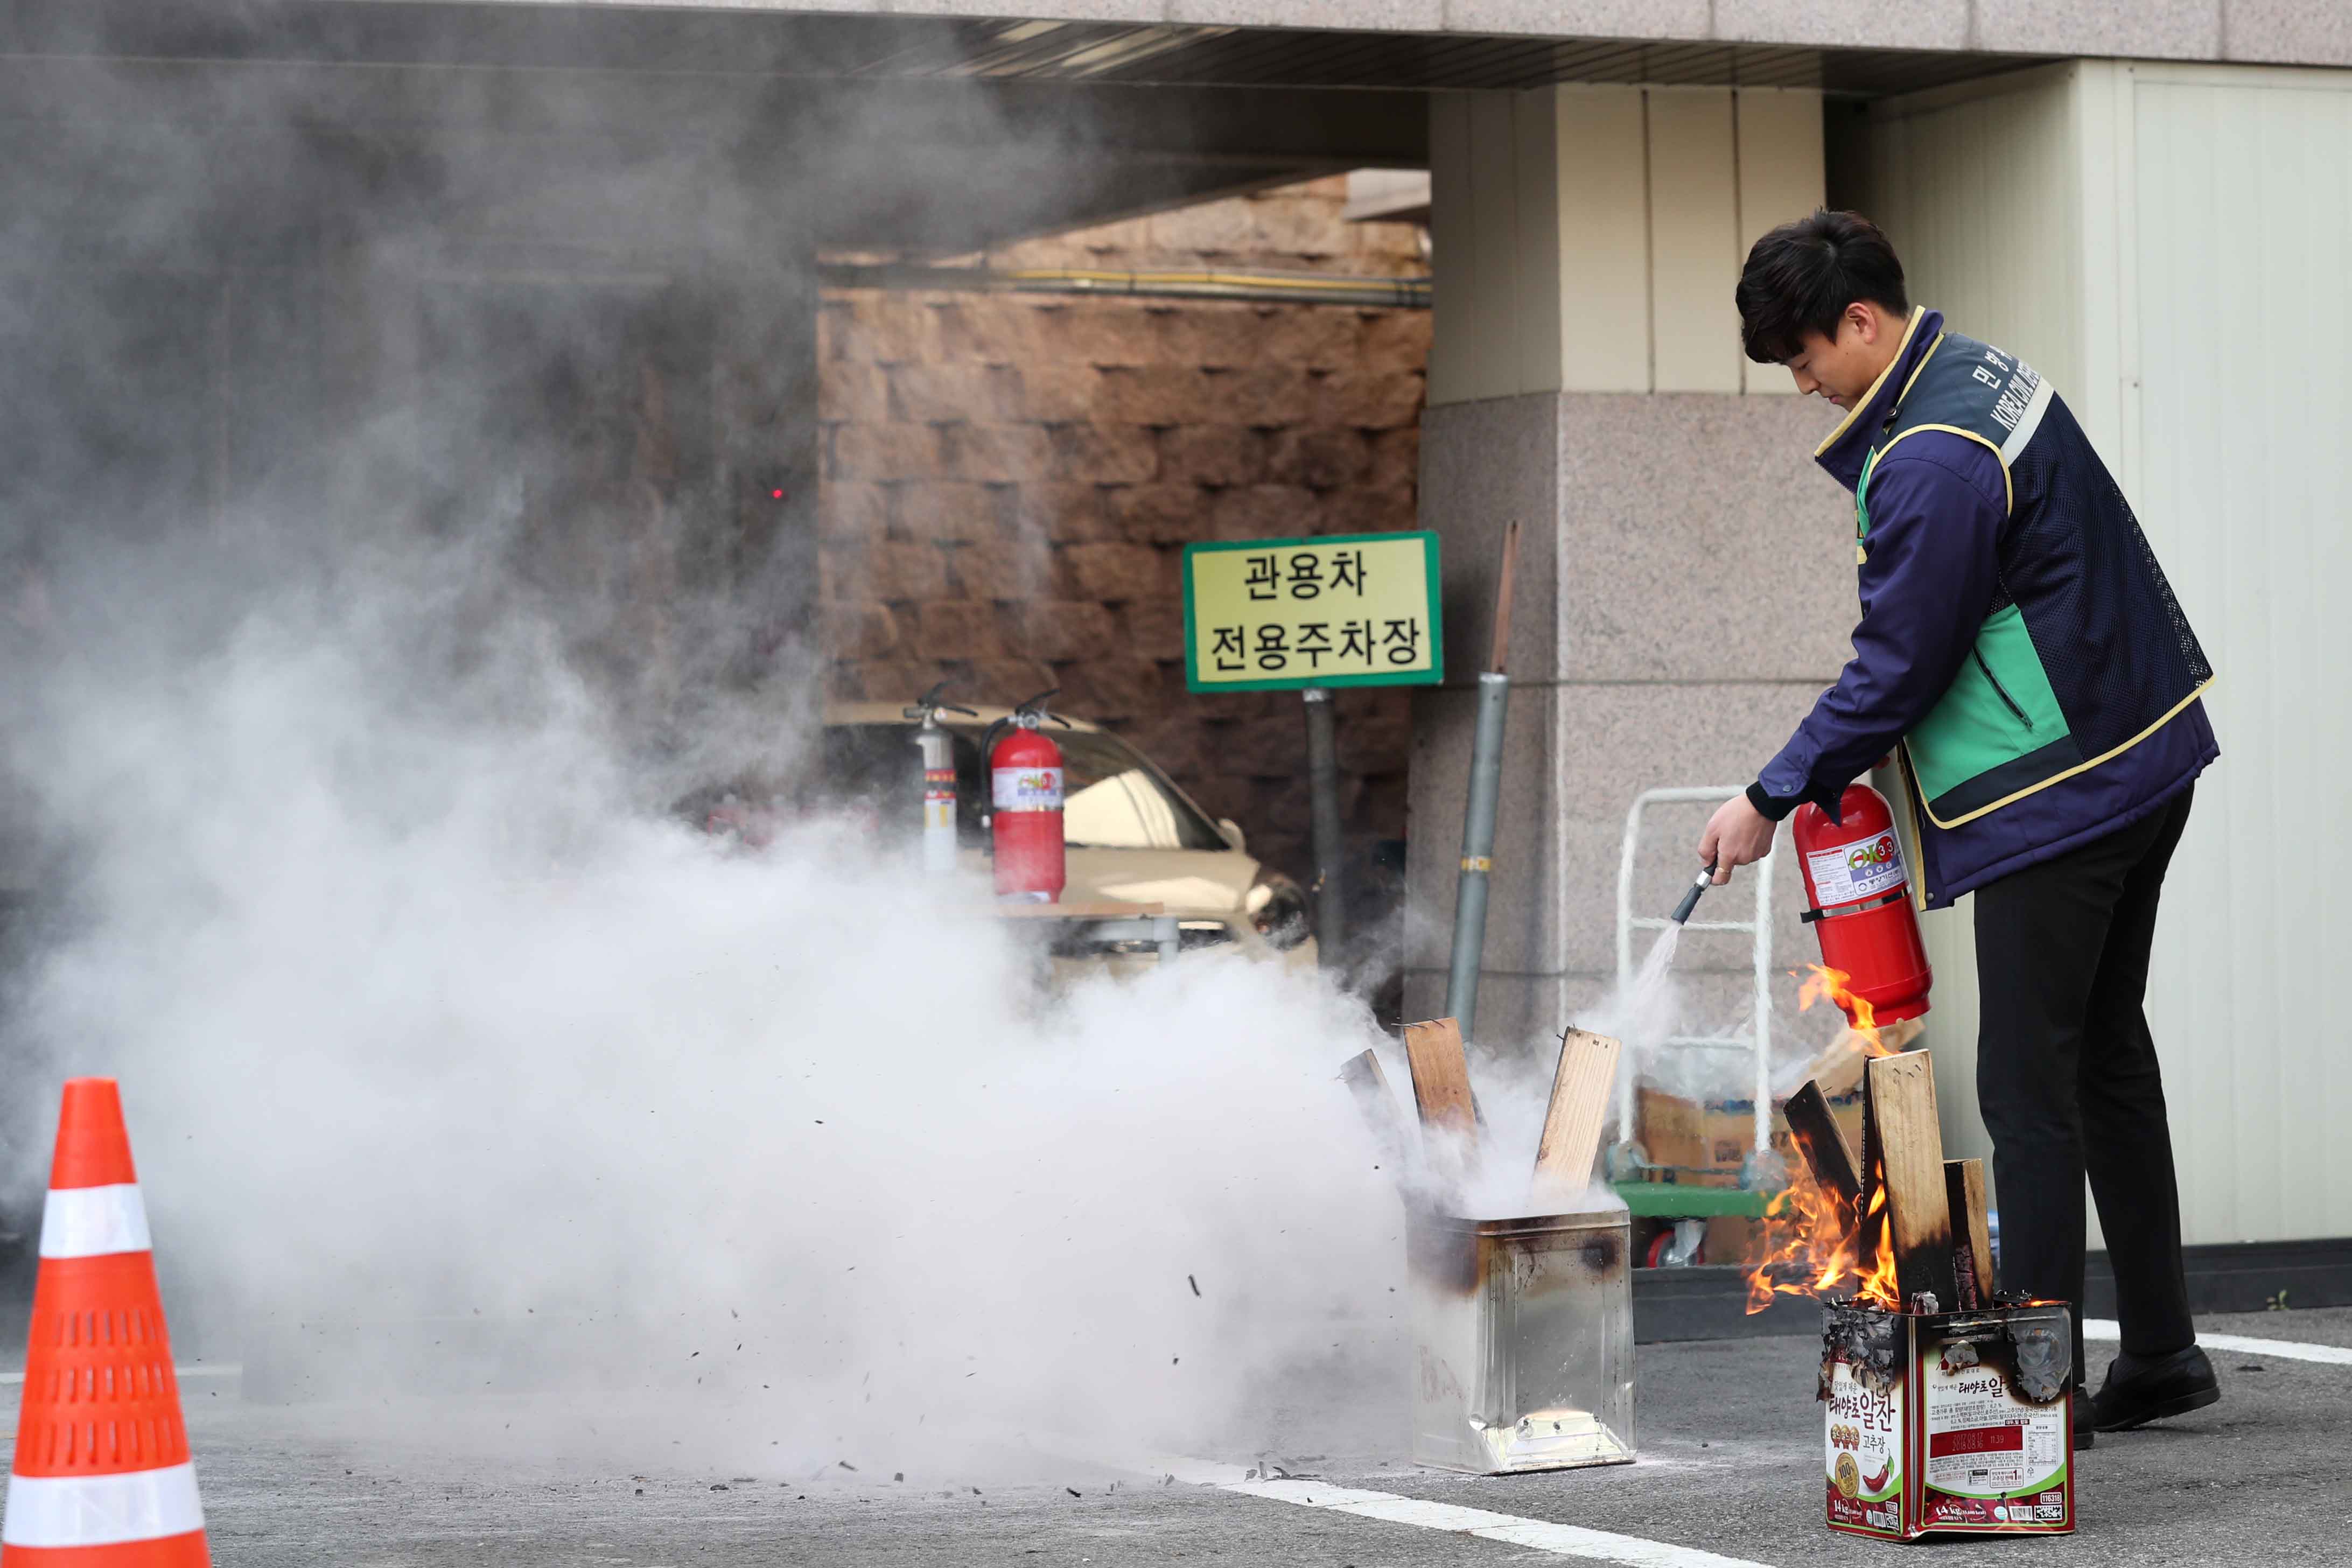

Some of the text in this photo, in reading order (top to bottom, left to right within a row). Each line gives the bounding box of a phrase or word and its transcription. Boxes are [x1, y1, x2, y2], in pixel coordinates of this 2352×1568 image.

[1990, 390, 2026, 431] KOREA
[1244, 550, 1367, 600] 관용차
[1212, 618, 1419, 671] 전용주차장
[1849, 842, 1883, 870] OK
[1959, 1381, 1988, 1394] 태양초
[1863, 1434, 1886, 1454] 고추장
